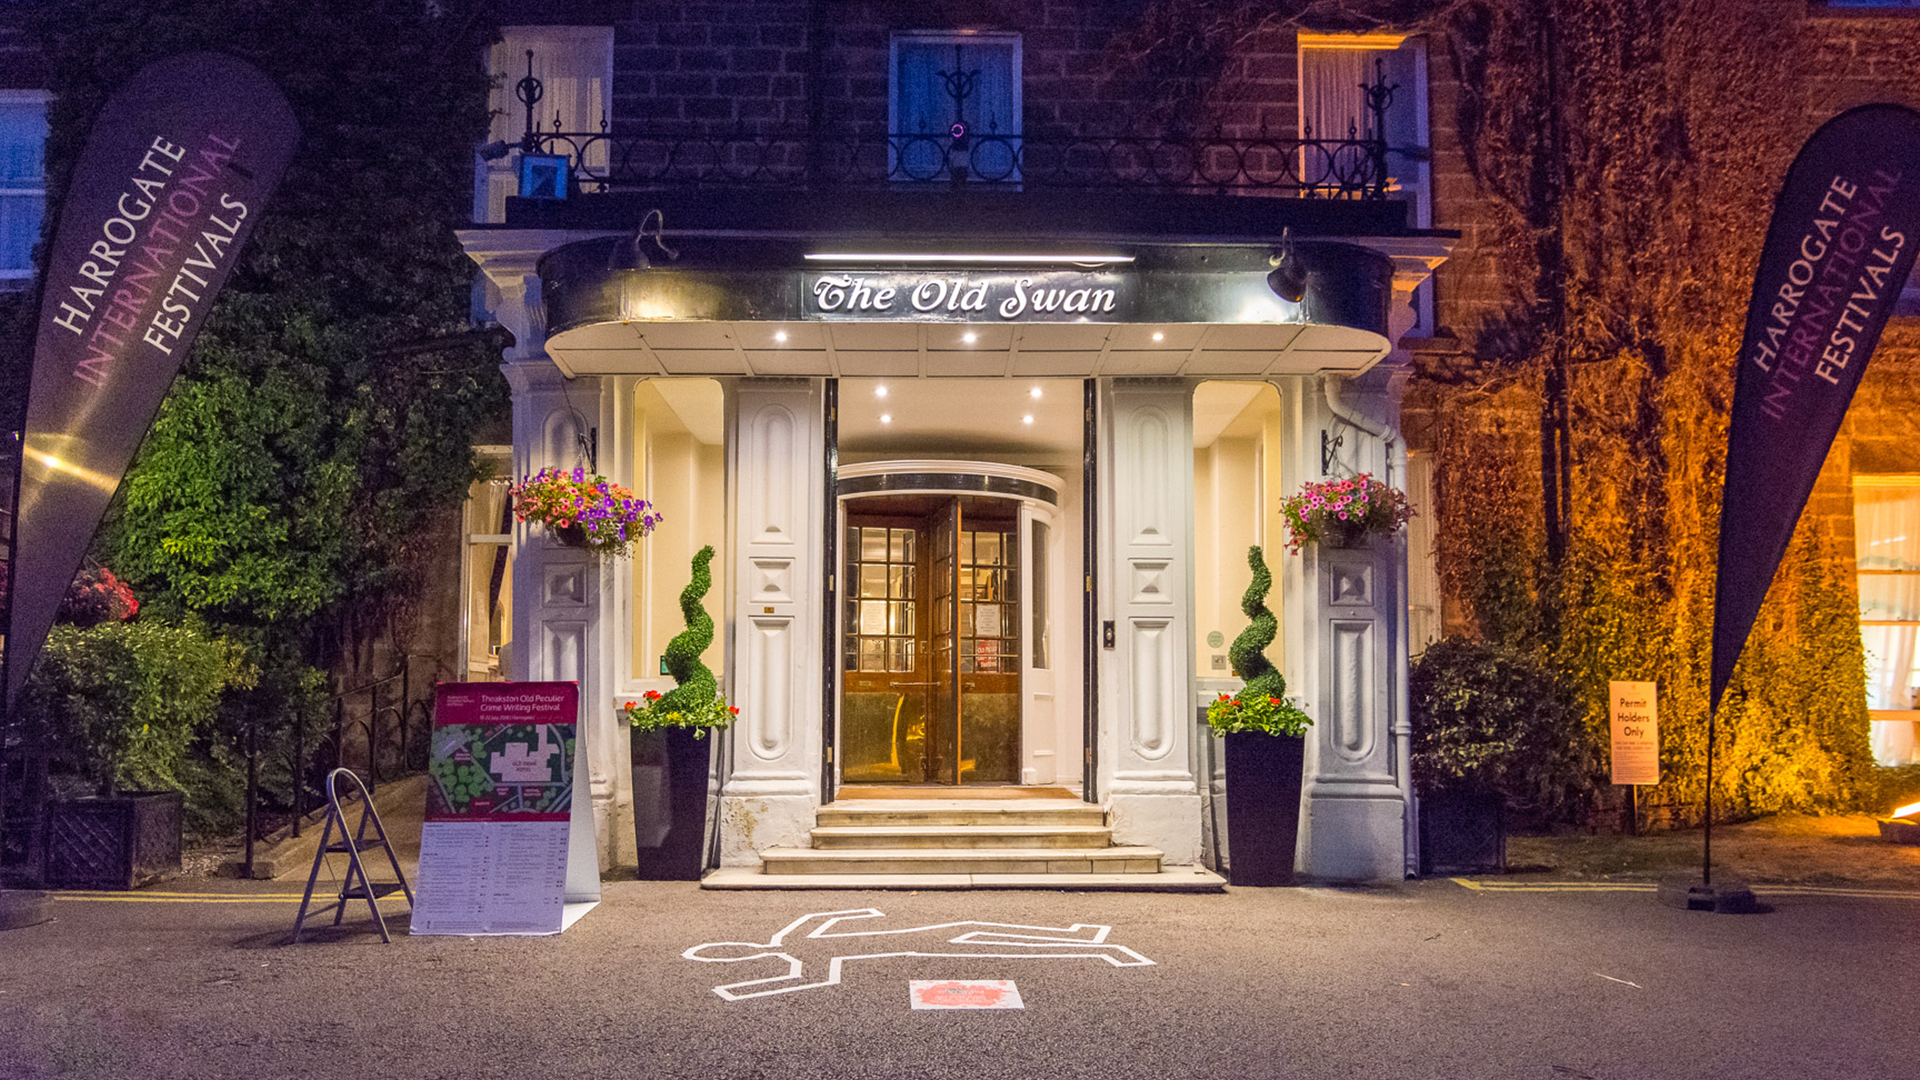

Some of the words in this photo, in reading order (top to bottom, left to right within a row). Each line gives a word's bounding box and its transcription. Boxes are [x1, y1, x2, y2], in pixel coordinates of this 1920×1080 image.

[53, 135, 186, 336] HARROGATE
[72, 133, 241, 388] INTERNATIONAL
[143, 192, 248, 356] FESTIVALS
[1753, 175, 1858, 372] HARROGATE
[813, 274, 896, 311] The
[911, 278, 990, 312] Old
[999, 278, 1116, 319] Swan
[1759, 169, 1902, 420] INTERNATIONAL
[1814, 225, 1905, 385] FESTIVALS
[480, 703, 502, 712] Crime
[503, 703, 531, 714] Writing
[532, 703, 561, 712] Festival
[481, 695, 519, 703] Theakston
[520, 695, 534, 703] Old
[535, 694, 565, 703] Peculier
[1617, 712, 1650, 723] Holders
[1620, 697, 1647, 708] Permit
[1624, 726, 1644, 739] Only
